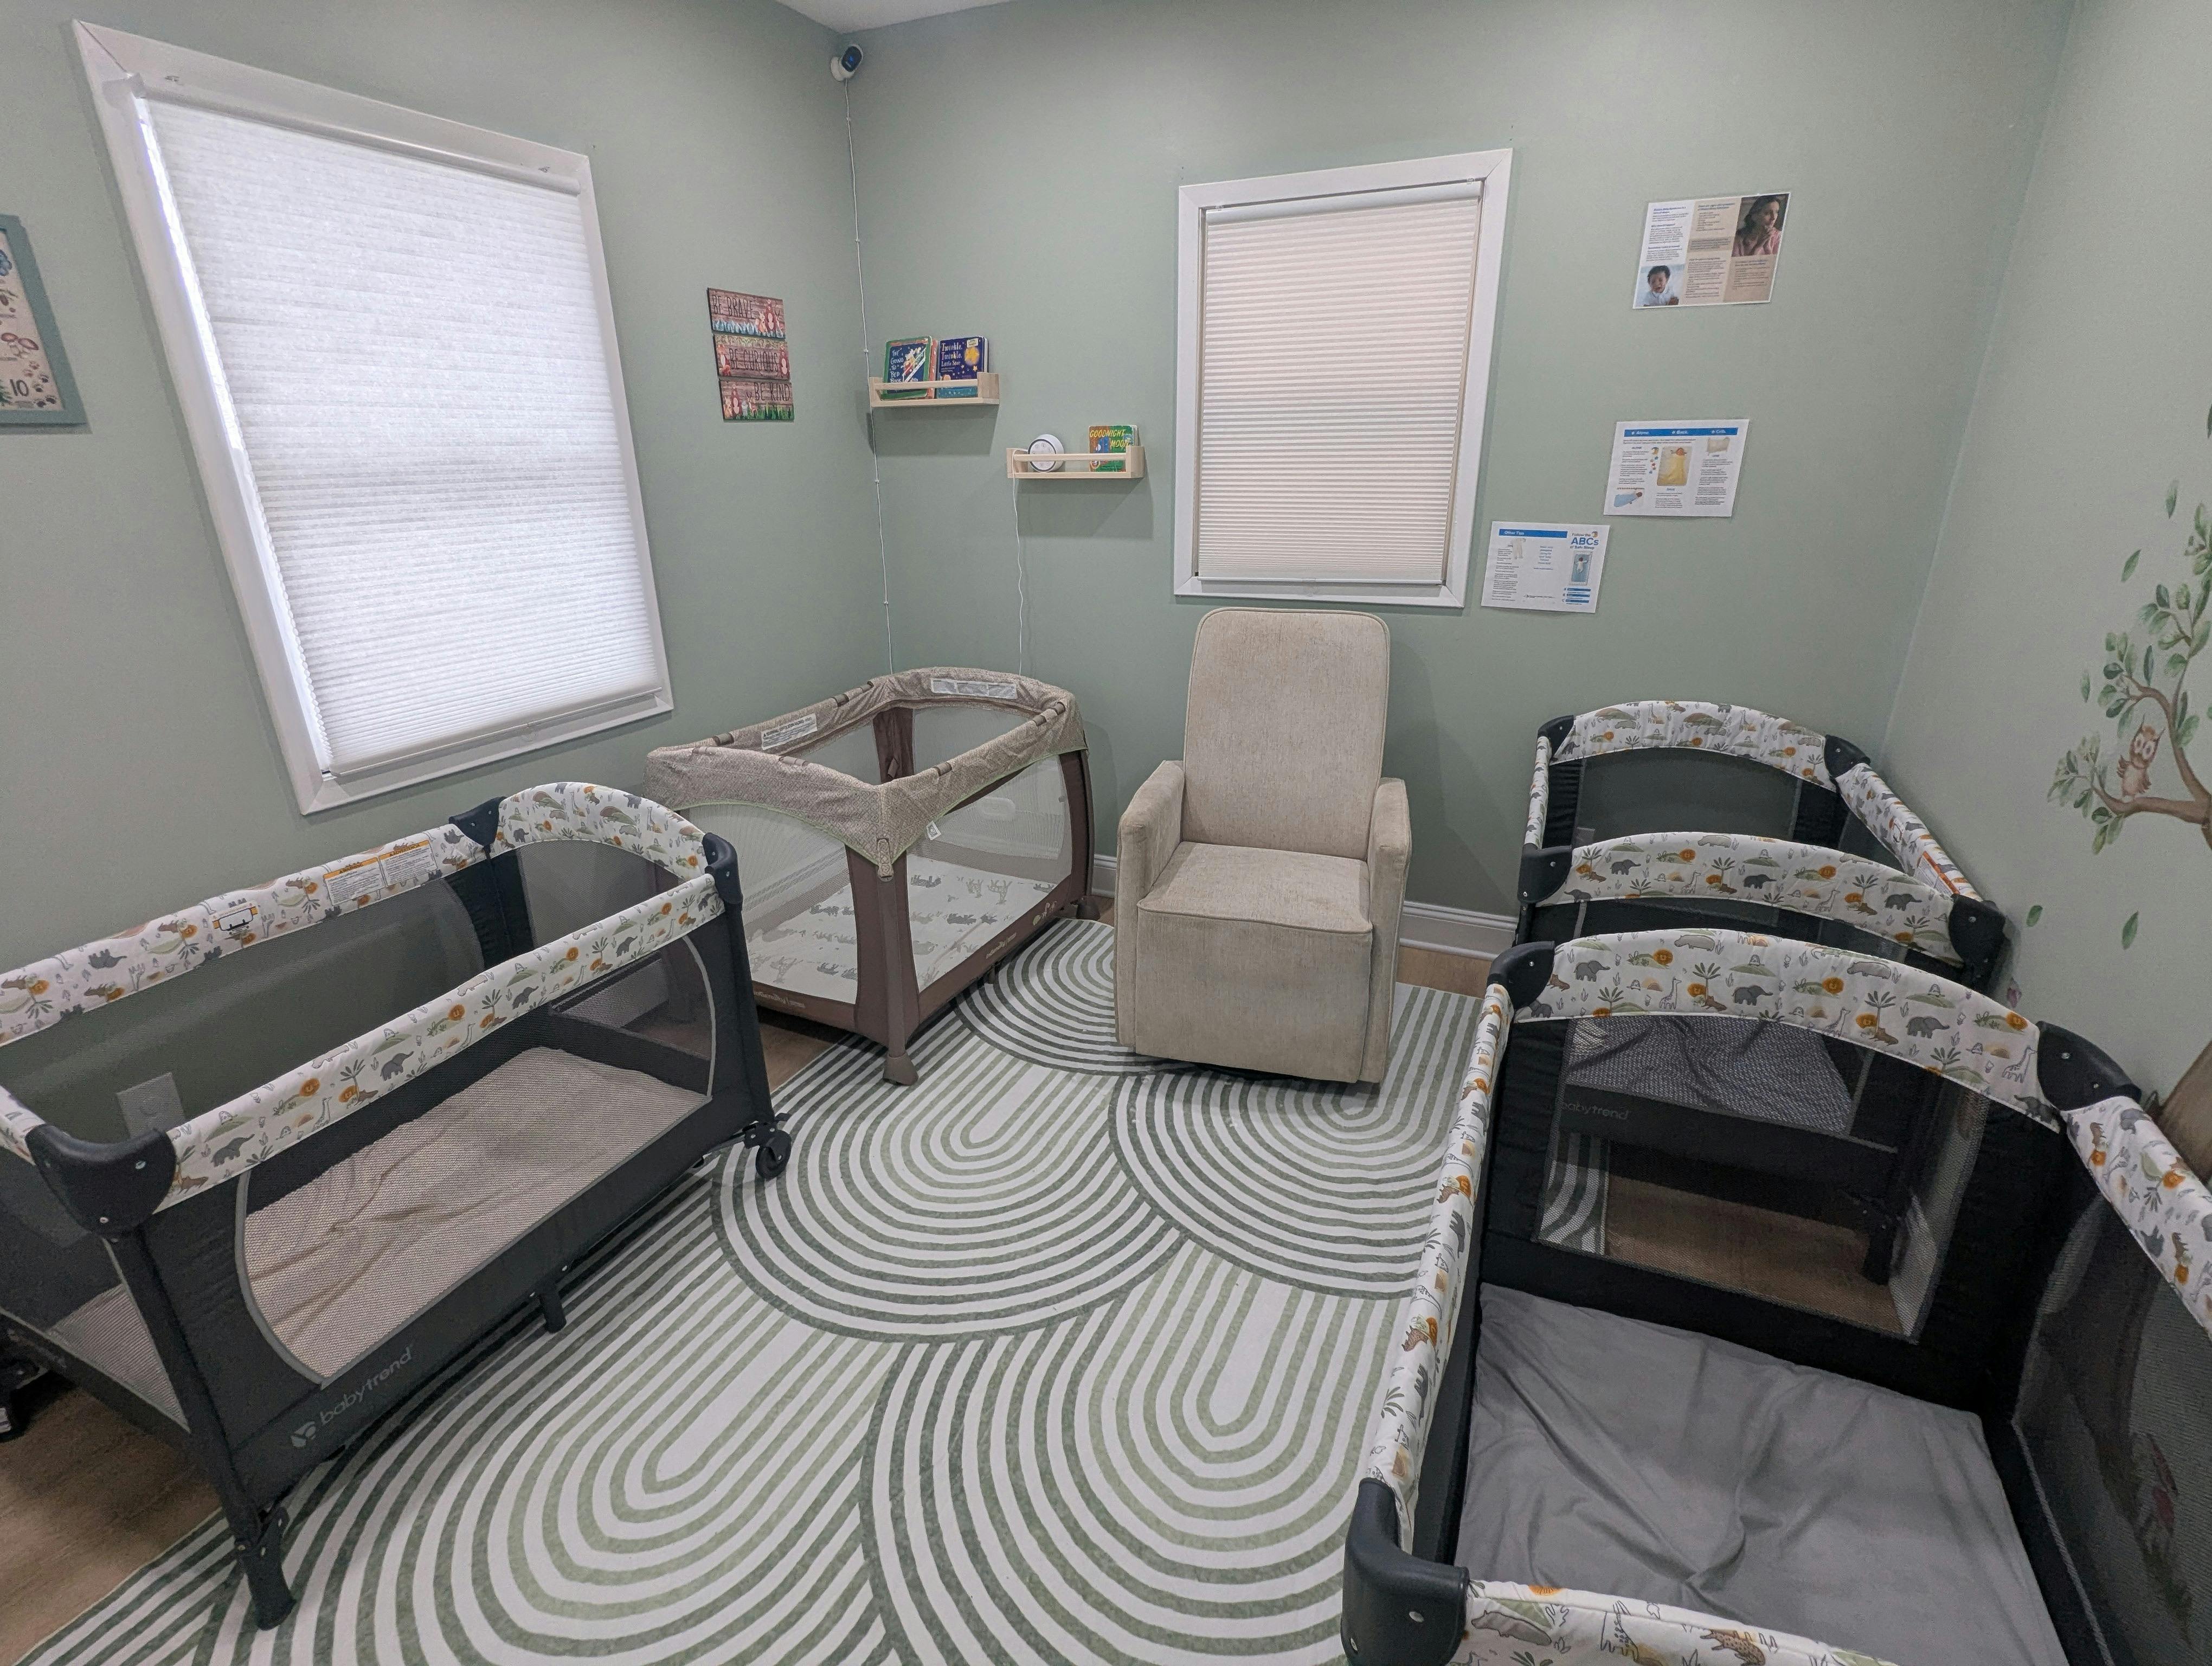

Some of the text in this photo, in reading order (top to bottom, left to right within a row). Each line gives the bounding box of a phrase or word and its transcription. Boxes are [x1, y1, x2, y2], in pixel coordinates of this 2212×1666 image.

[712, 294, 756, 319] BE BRAVE
[729, 348, 780, 373] BE CURIOUS
[10, 379, 30, 397] 10
[754, 382, 791, 401] BE KIND
[1090, 430, 1125, 438] GOODNIGHT
[1110, 440, 1129, 448] MOON
[1571, 537, 1599, 546] ABCs
[320, 1345, 413, 1425] babytrend
